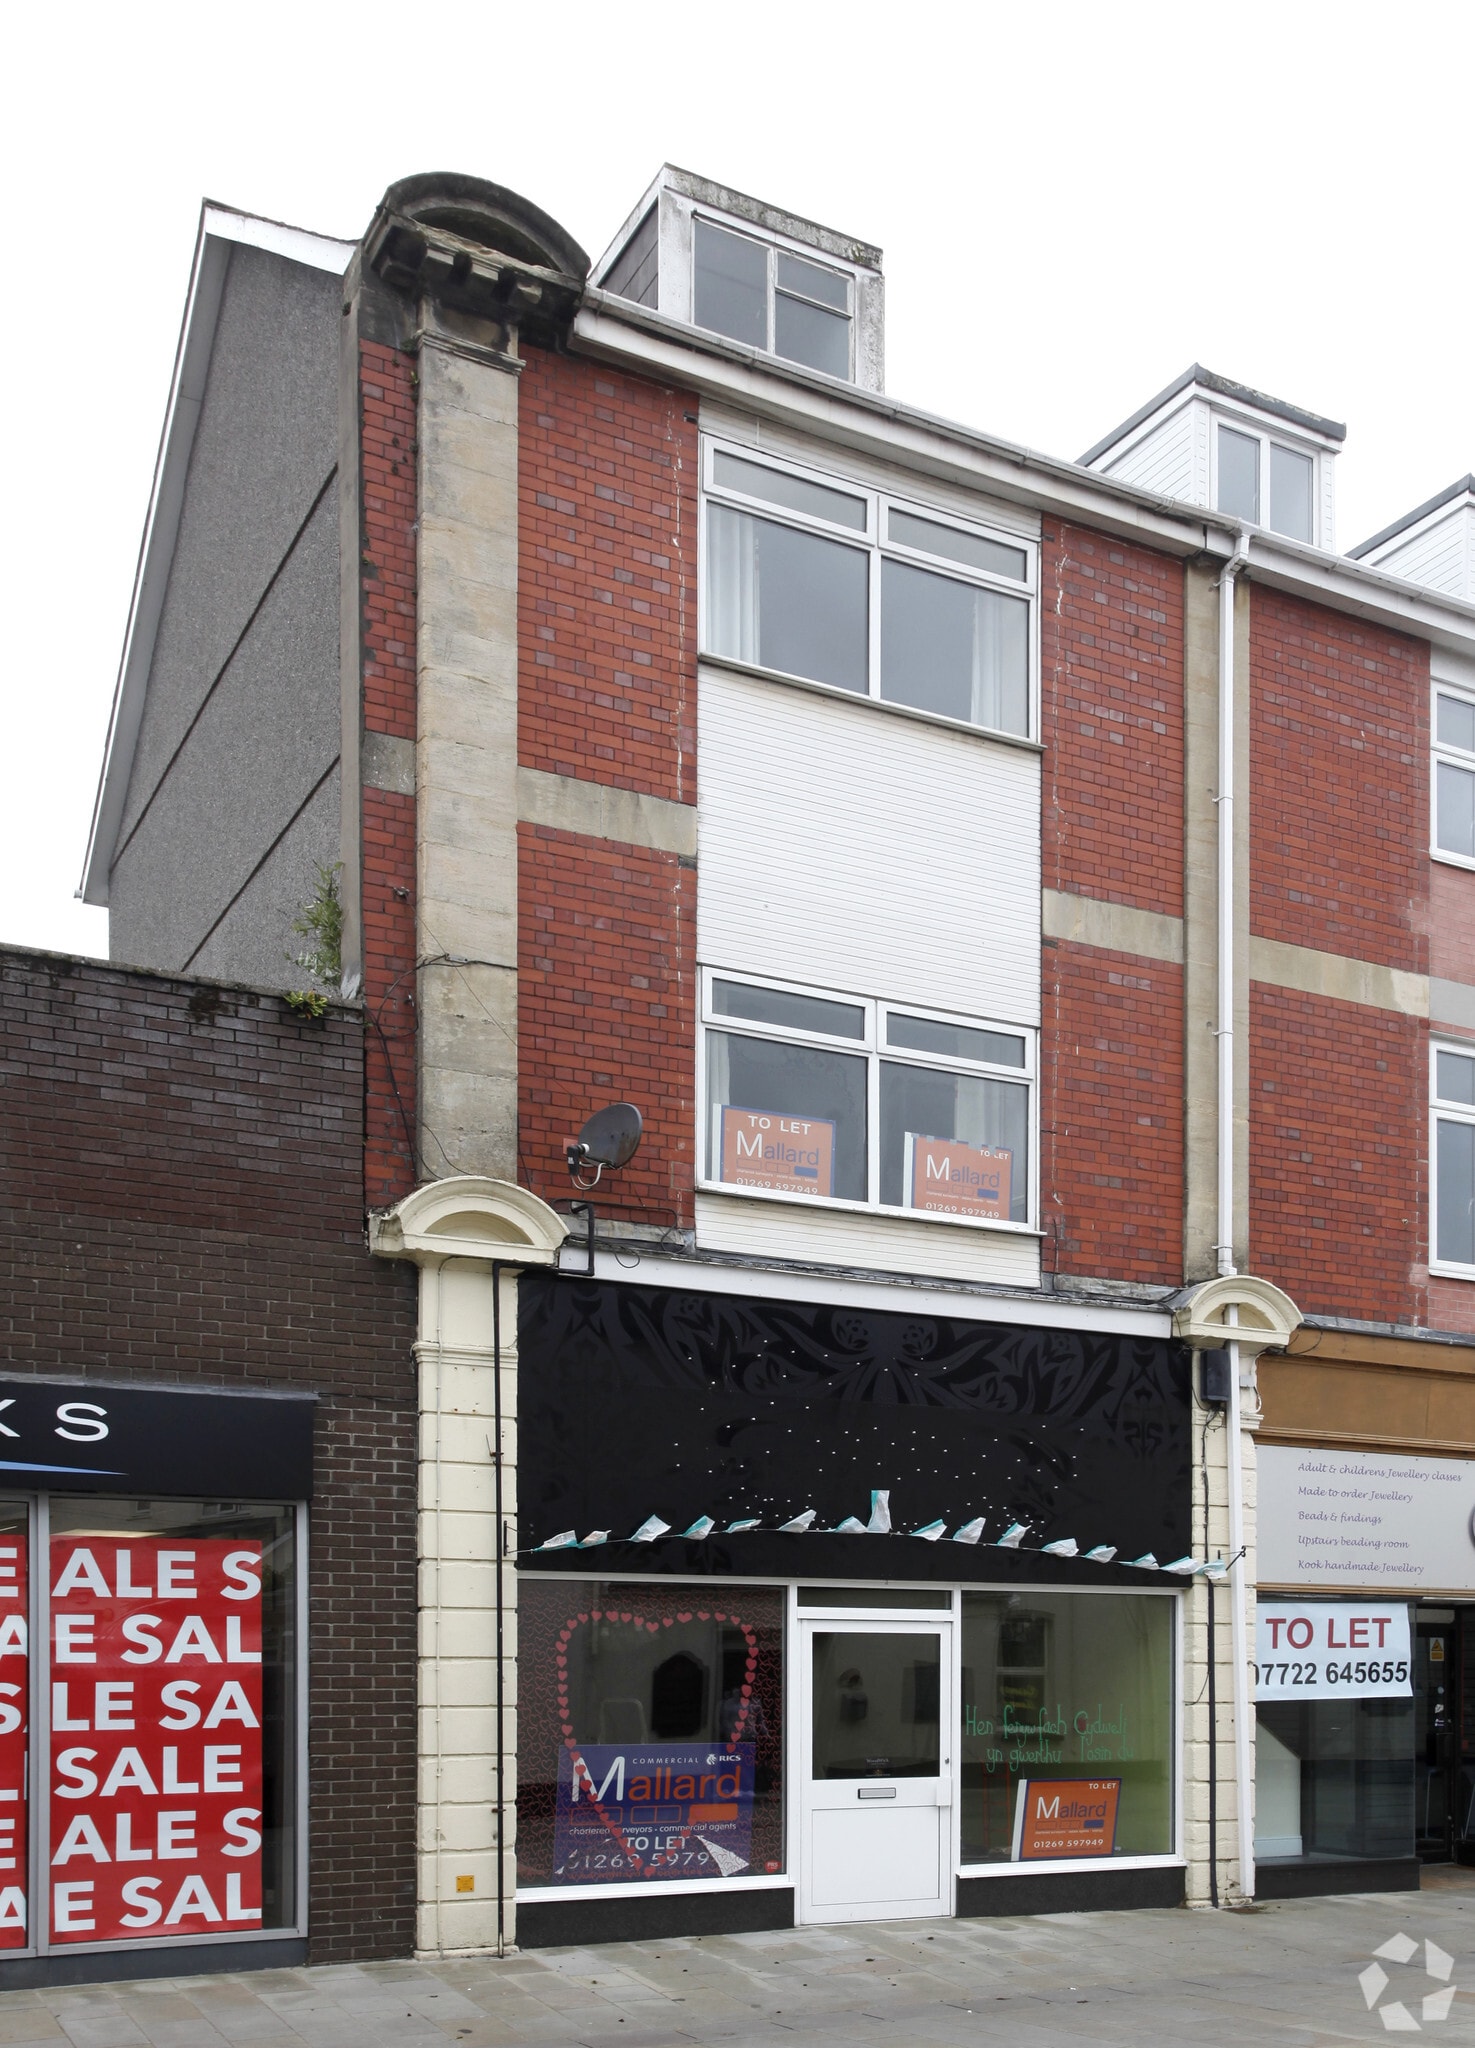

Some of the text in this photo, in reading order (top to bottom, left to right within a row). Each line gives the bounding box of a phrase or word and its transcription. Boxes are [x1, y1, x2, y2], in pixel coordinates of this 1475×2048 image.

[747, 1115, 811, 1135] TO LET
[736, 1130, 819, 1166] Mallard
[980, 1149, 990, 1157] TO
[926, 1154, 1000, 1188] Mallard
[736, 1177, 818, 1195] 01269 597949
[925, 1202, 1000, 1219] 01269 597949
[1297, 1462, 1462, 1482] Adult & childrens Jewellery classes
[1298, 1486, 1414, 1504] Made to order Jewellery
[1298, 1511, 1383, 1526] Beads & findings
[1298, 1536, 1338, 1547] Upstairs
[1340, 1536, 1382, 1550] beading
[1298, 1560, 1425, 1576] Kook handmade Jewellery
[1265, 1617, 1392, 1649] TO LET
[1256, 1661, 1408, 1685] 7722 645655
[966, 1704, 994, 1736] Hen
[719, 1754, 742, 1762] RICS
[54, 1745, 243, 1799] SALE
[571, 1756, 741, 1802] Mallard
[1036, 1795, 1107, 1819] Mallard
[621, 1826, 653, 1836] rveyors
[659, 1823, 707, 1832] commercial
[709, 1823, 737, 1833] agents
[626, 1836, 689, 1850] TO LET
[1033, 1839, 1104, 1849] 01269 597949
